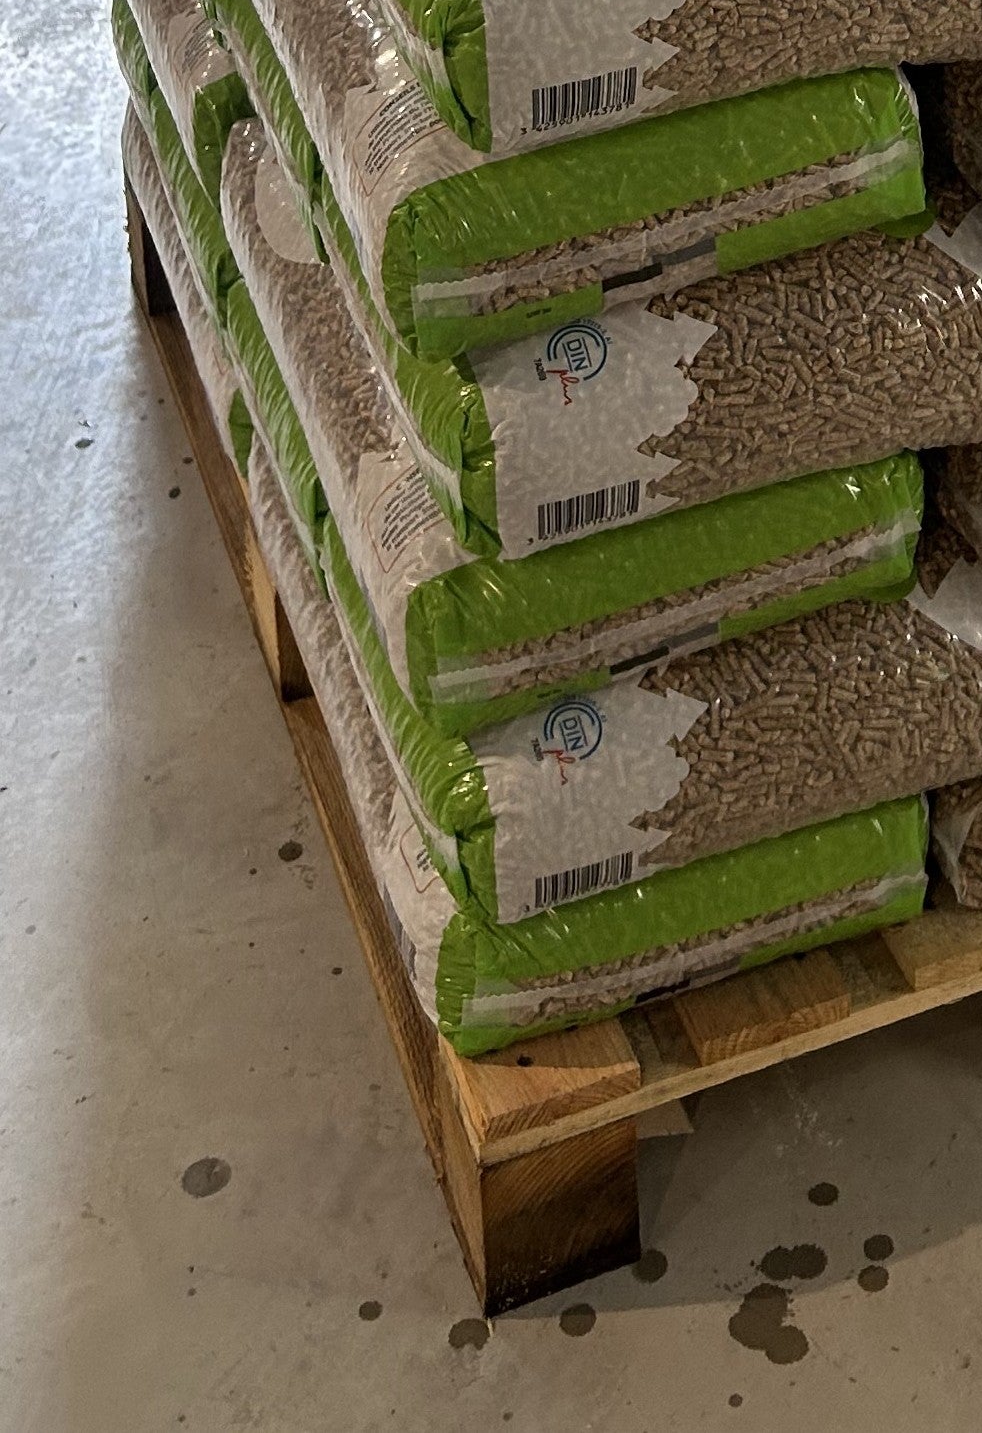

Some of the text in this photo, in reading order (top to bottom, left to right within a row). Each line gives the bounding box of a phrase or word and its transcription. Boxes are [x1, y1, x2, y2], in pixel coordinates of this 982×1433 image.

[566, 338, 589, 372] DIN
[546, 369, 580, 406] plus
[563, 717, 585, 751] DIN
[543, 749, 576, 786] plus
